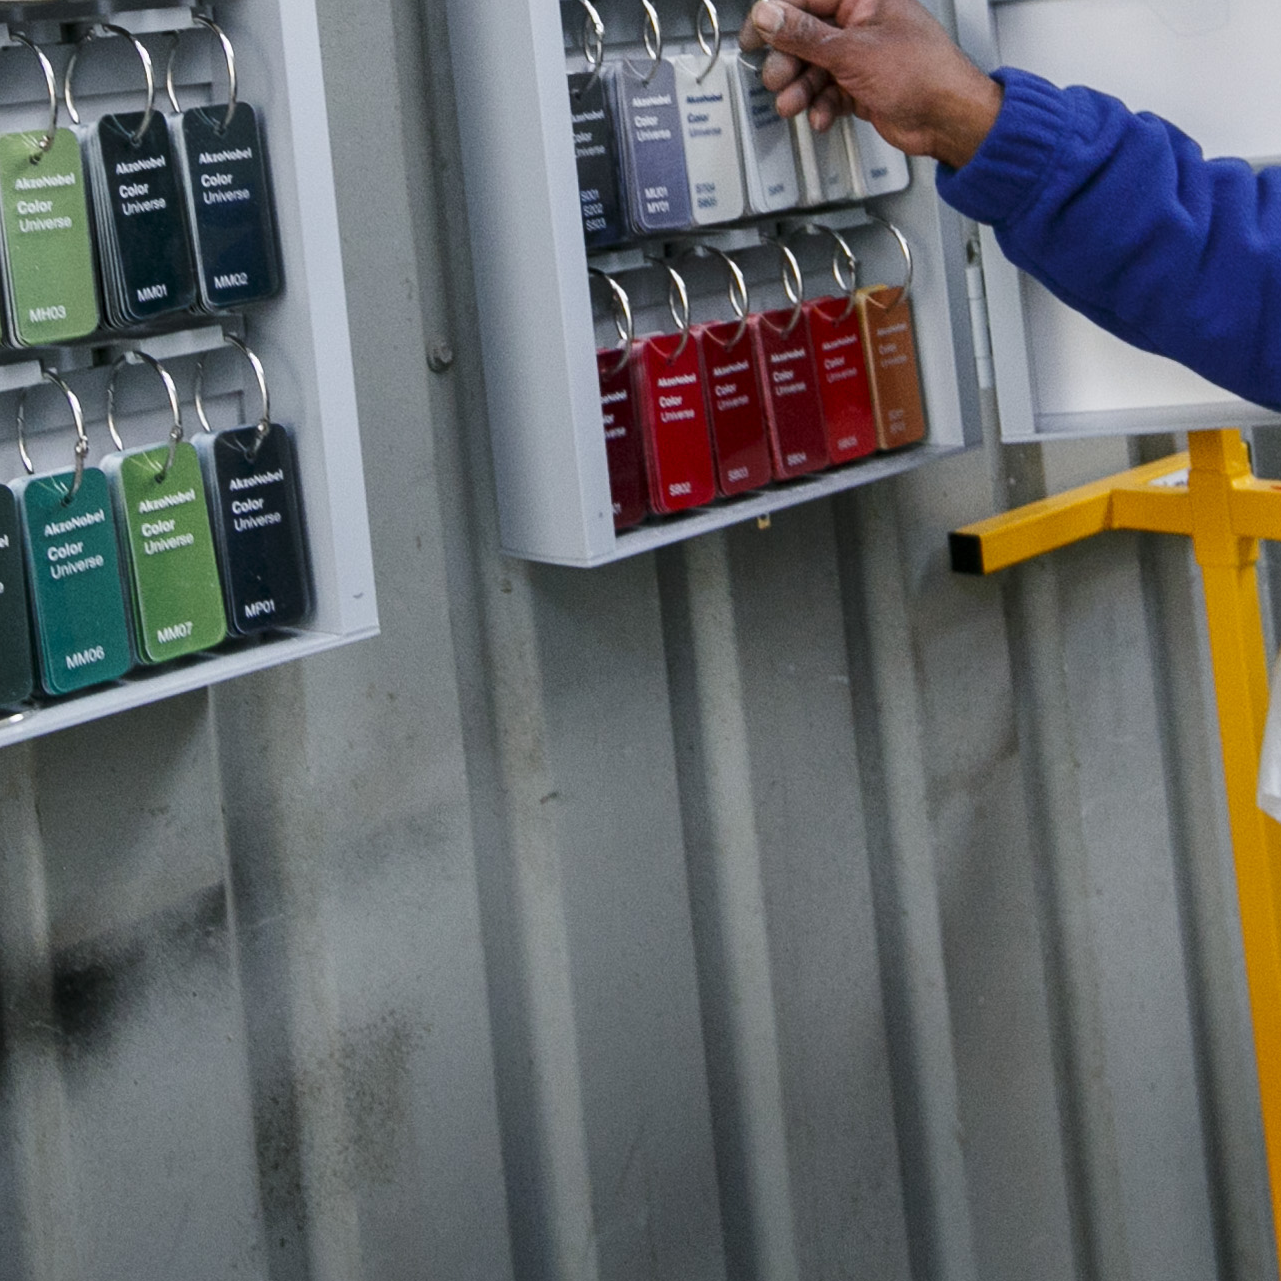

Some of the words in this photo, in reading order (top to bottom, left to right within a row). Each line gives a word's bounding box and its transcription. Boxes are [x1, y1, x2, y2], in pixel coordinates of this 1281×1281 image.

[199, 148, 252, 163] AkzoNobel
[116, 155, 166, 174] AkzoNobel
[15, 173, 75, 189] AkzoNobel
[201, 173, 232, 187] Color
[119, 184, 149, 198] Color
[203, 189, 250, 204] Universe
[17, 200, 53, 214] Color
[122, 198, 166, 215] Universe
[19, 217, 72, 232] Universe
[214, 272, 248, 288] MM02
[137, 284, 167, 301] MM01
[29, 305, 66, 322] MH03
[230, 469, 283, 490] AkzoNobel
[139, 489, 195, 512] AkzoNobel
[232, 498, 263, 514] Color
[45, 509, 104, 536] AkzoNobel
[142, 520, 175, 536] Color
[234, 512, 281, 531] Universe
[47, 542, 83, 561] Color
[144, 533, 194, 554] Universe
[50, 555, 103, 579] Universe
[245, 599, 275, 618] MP01
[157, 621, 193, 642] MM07
[66, 646, 105, 669] MM06
